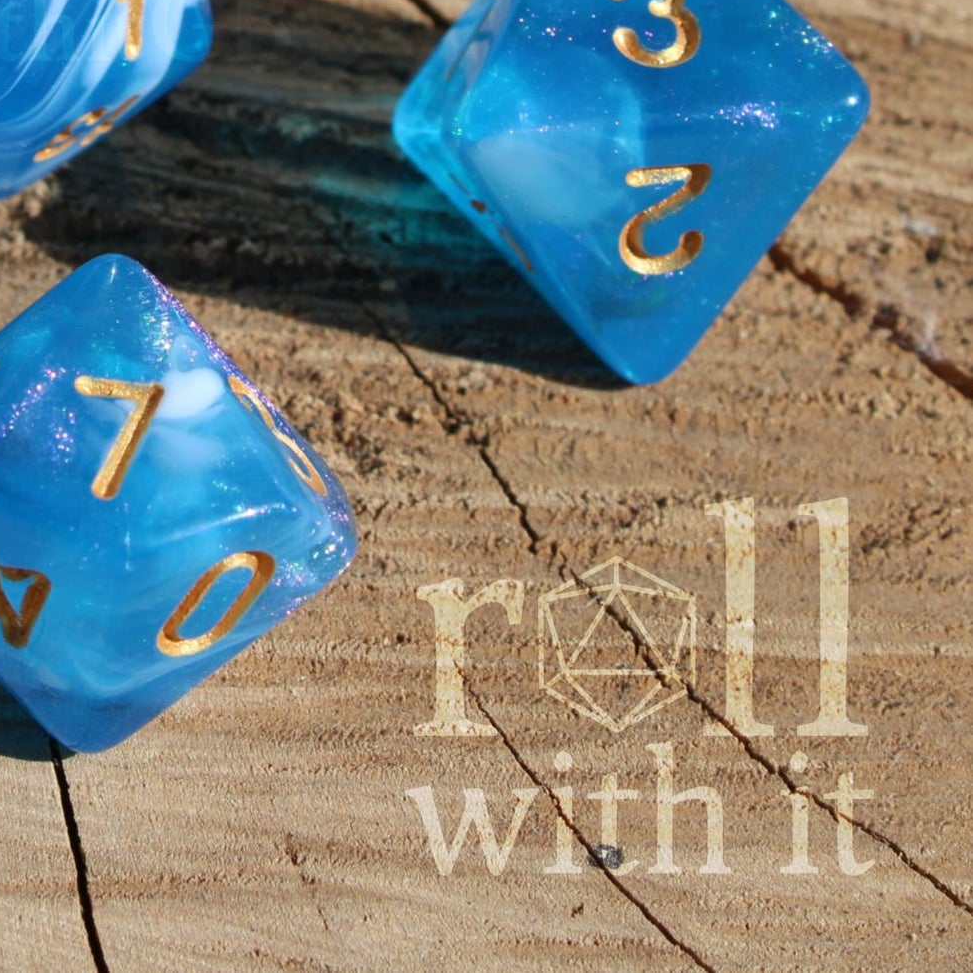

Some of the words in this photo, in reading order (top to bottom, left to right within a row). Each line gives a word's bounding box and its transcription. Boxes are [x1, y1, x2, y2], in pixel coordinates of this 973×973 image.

[618, 162, 713, 276] 2
[73, 374, 165, 501] 7
[155, 549, 277, 658] 0
